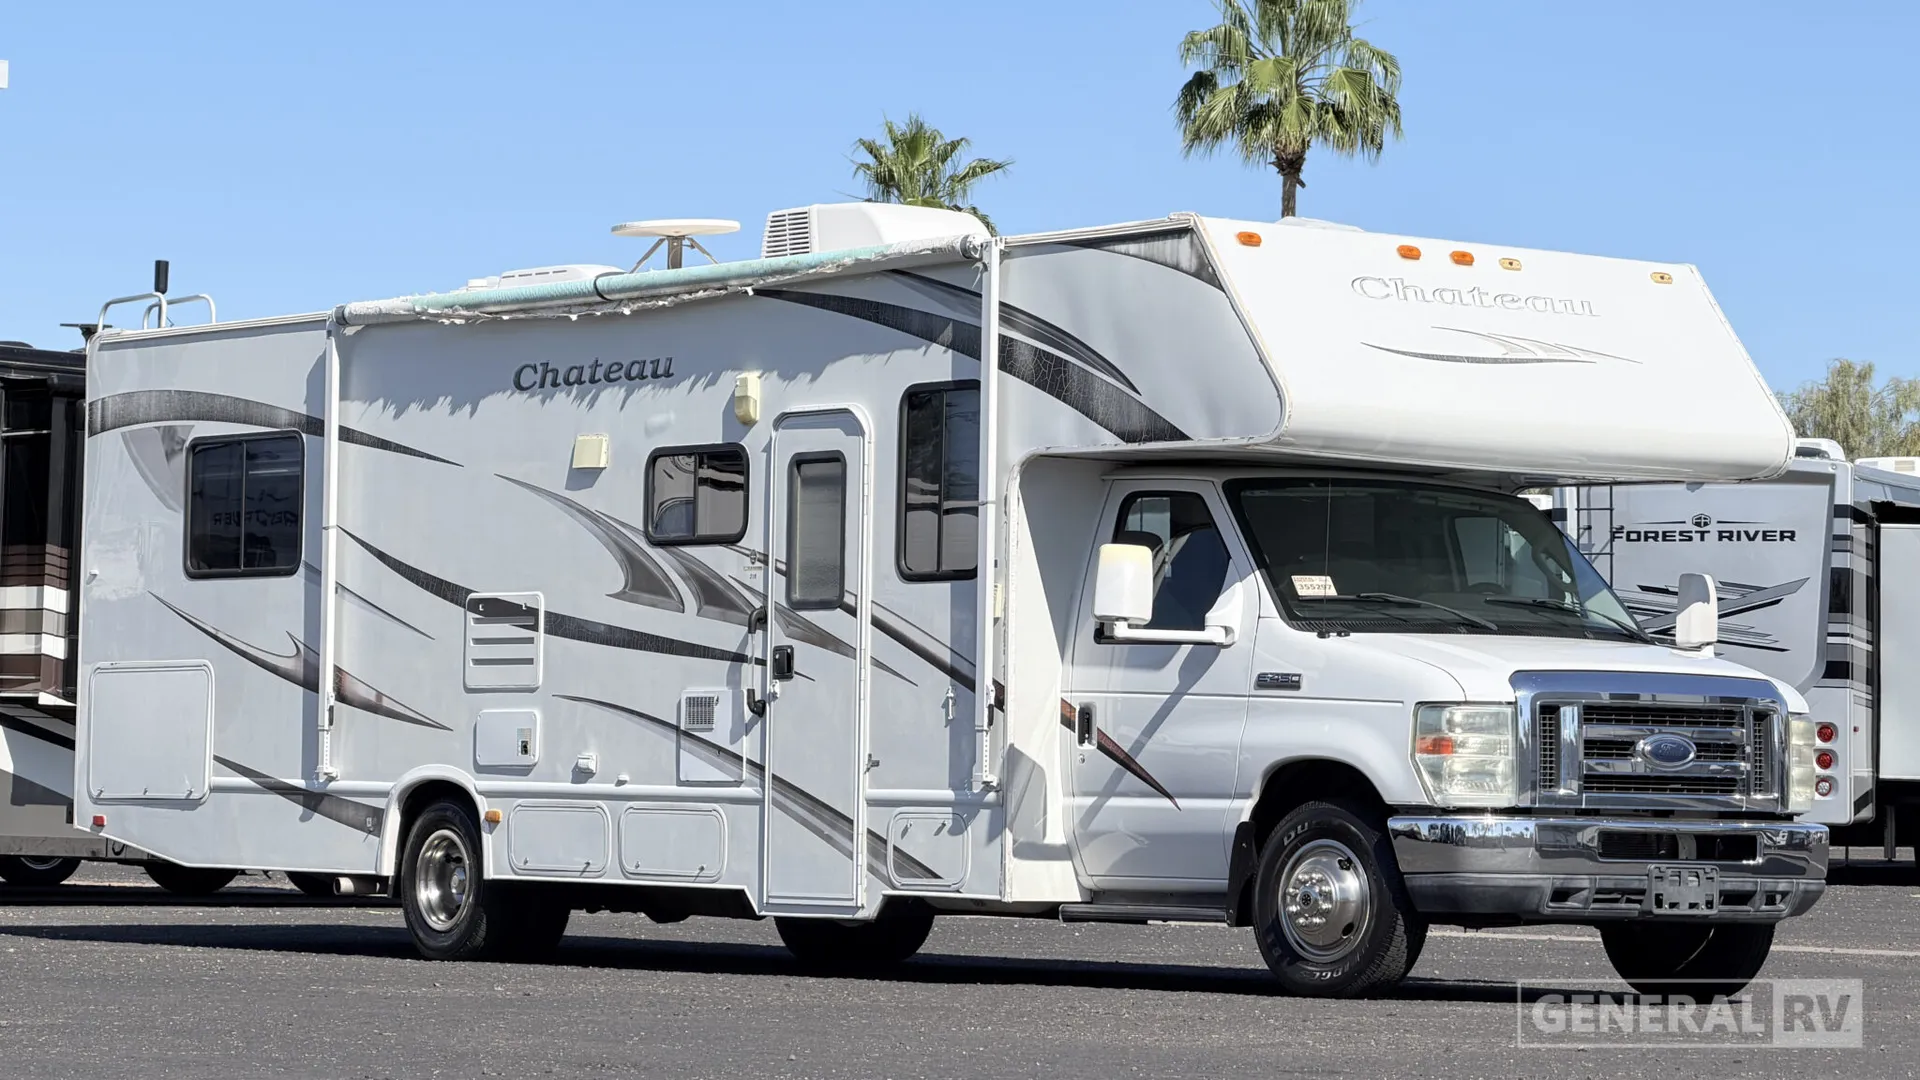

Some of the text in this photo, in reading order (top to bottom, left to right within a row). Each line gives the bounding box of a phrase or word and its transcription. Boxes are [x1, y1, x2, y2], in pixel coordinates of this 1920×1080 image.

[1351, 276, 1601, 316] Chateau
[512, 357, 675, 391] Chateau
[1612, 530, 1796, 542] FOREST RIVER
